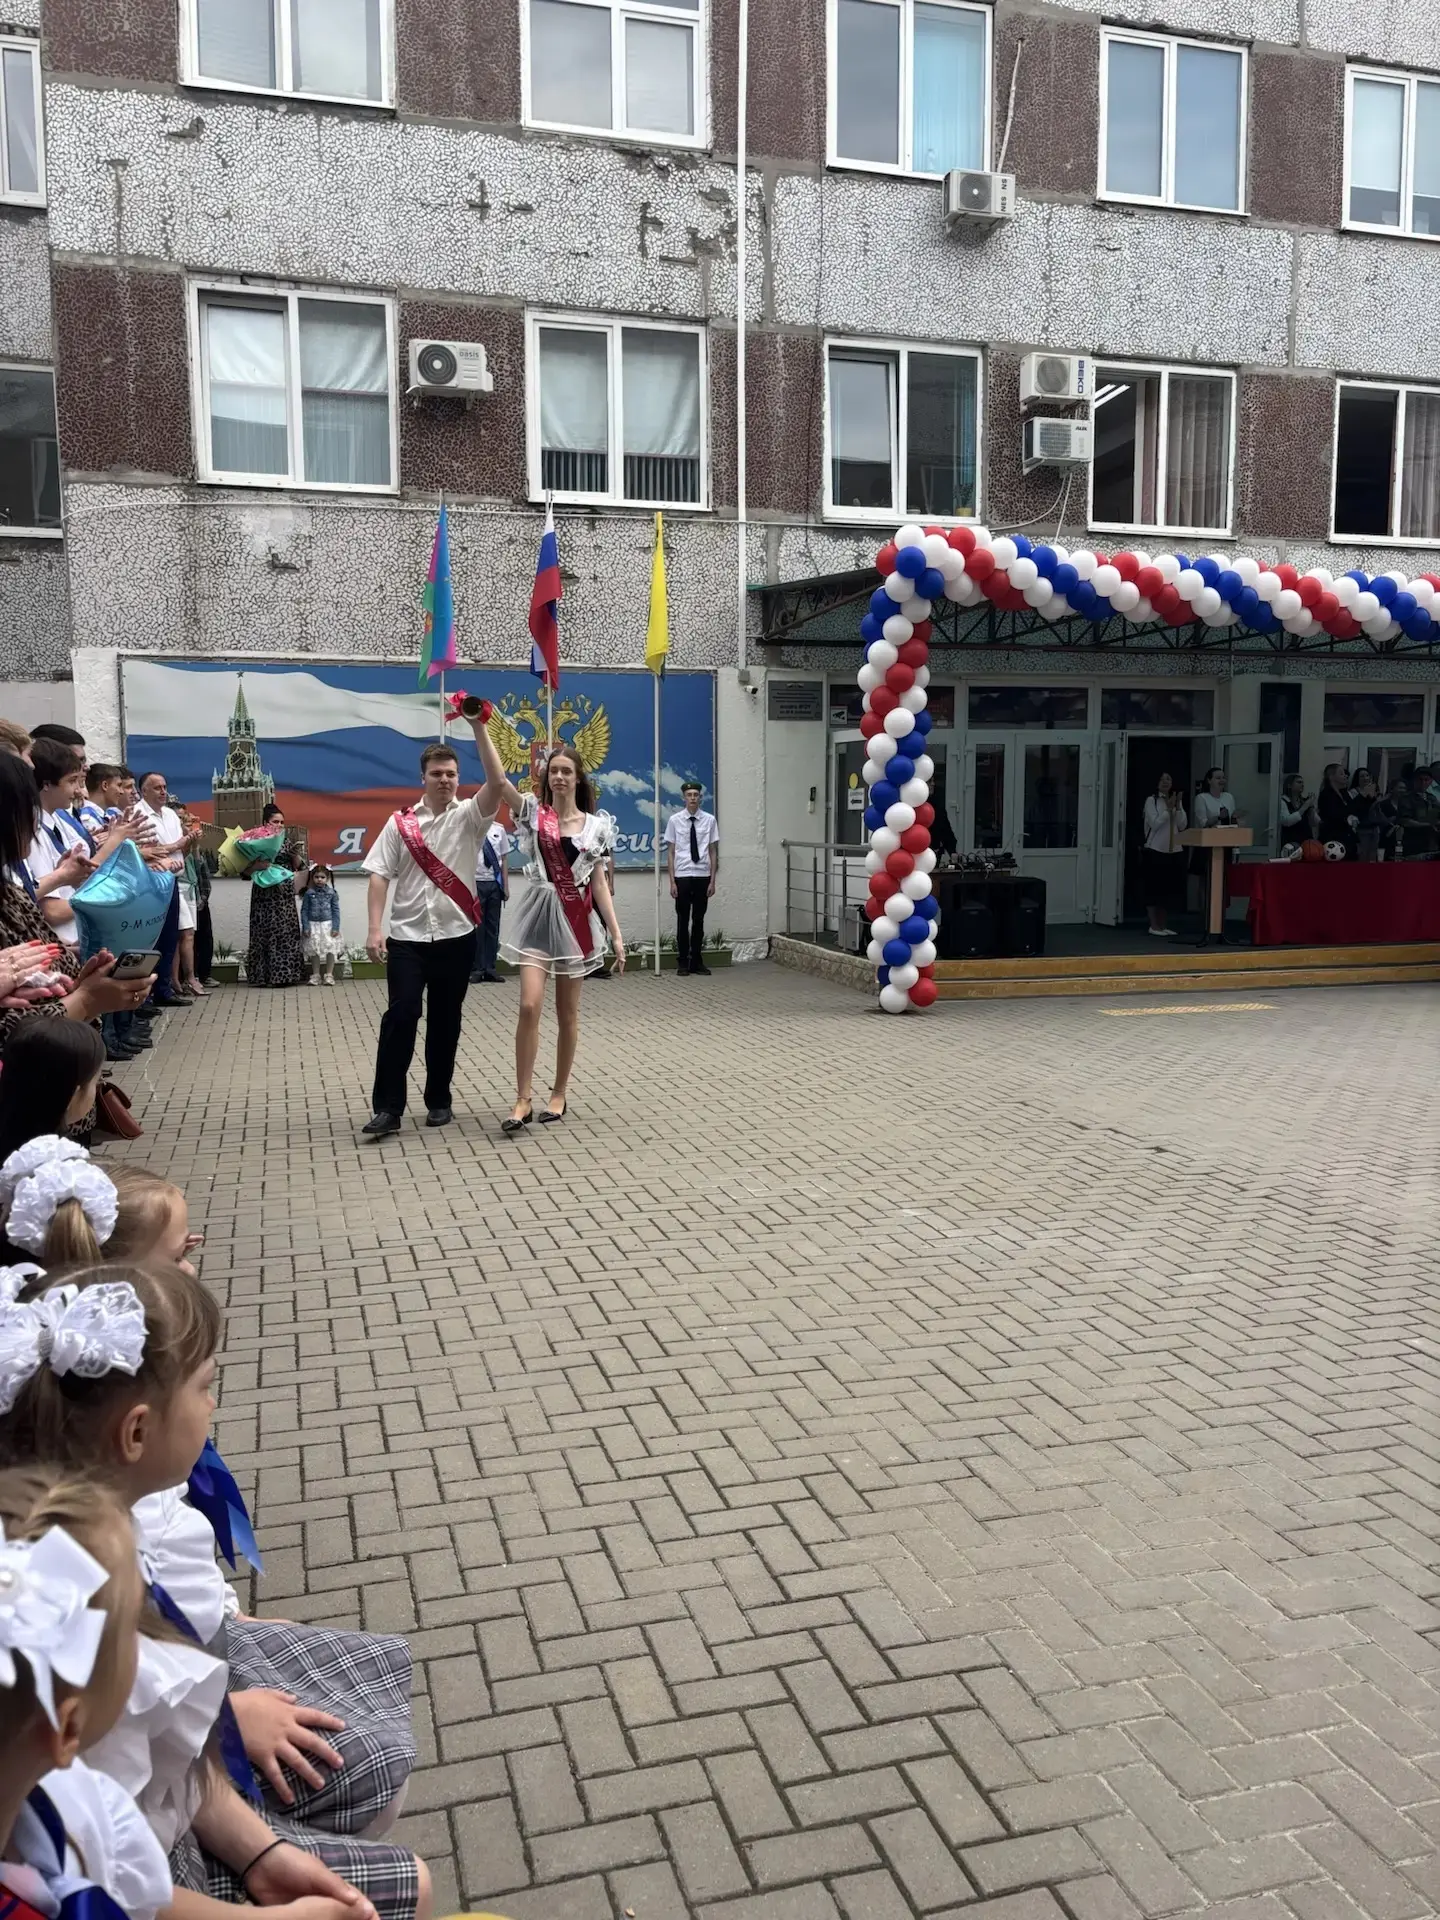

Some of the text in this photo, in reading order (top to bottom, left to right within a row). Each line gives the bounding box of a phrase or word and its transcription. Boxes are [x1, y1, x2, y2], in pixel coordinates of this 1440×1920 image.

[1077, 360, 1085, 394] BEKO
[333, 827, 367, 854] Я
[428, 863, 458, 889] 2026
[555, 872, 581, 902] 2026
